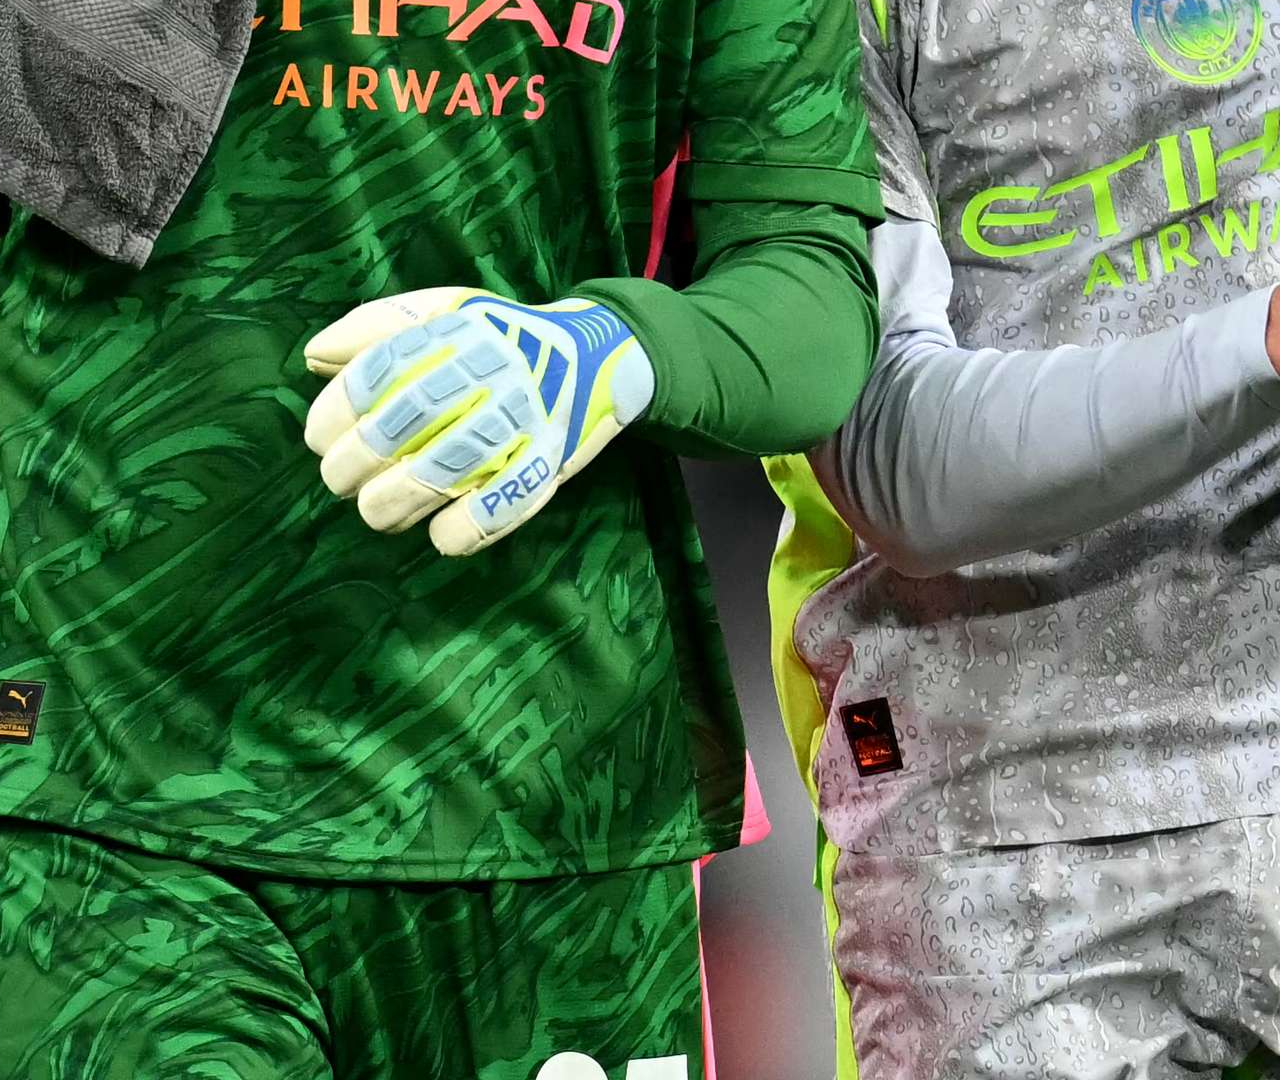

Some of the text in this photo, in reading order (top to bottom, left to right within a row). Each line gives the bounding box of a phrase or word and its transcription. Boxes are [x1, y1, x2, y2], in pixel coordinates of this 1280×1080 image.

[273, 63, 546, 120] AIRWAYS
[1198, 54, 1233, 75] CITY
[480, 455, 551, 517] PRED
